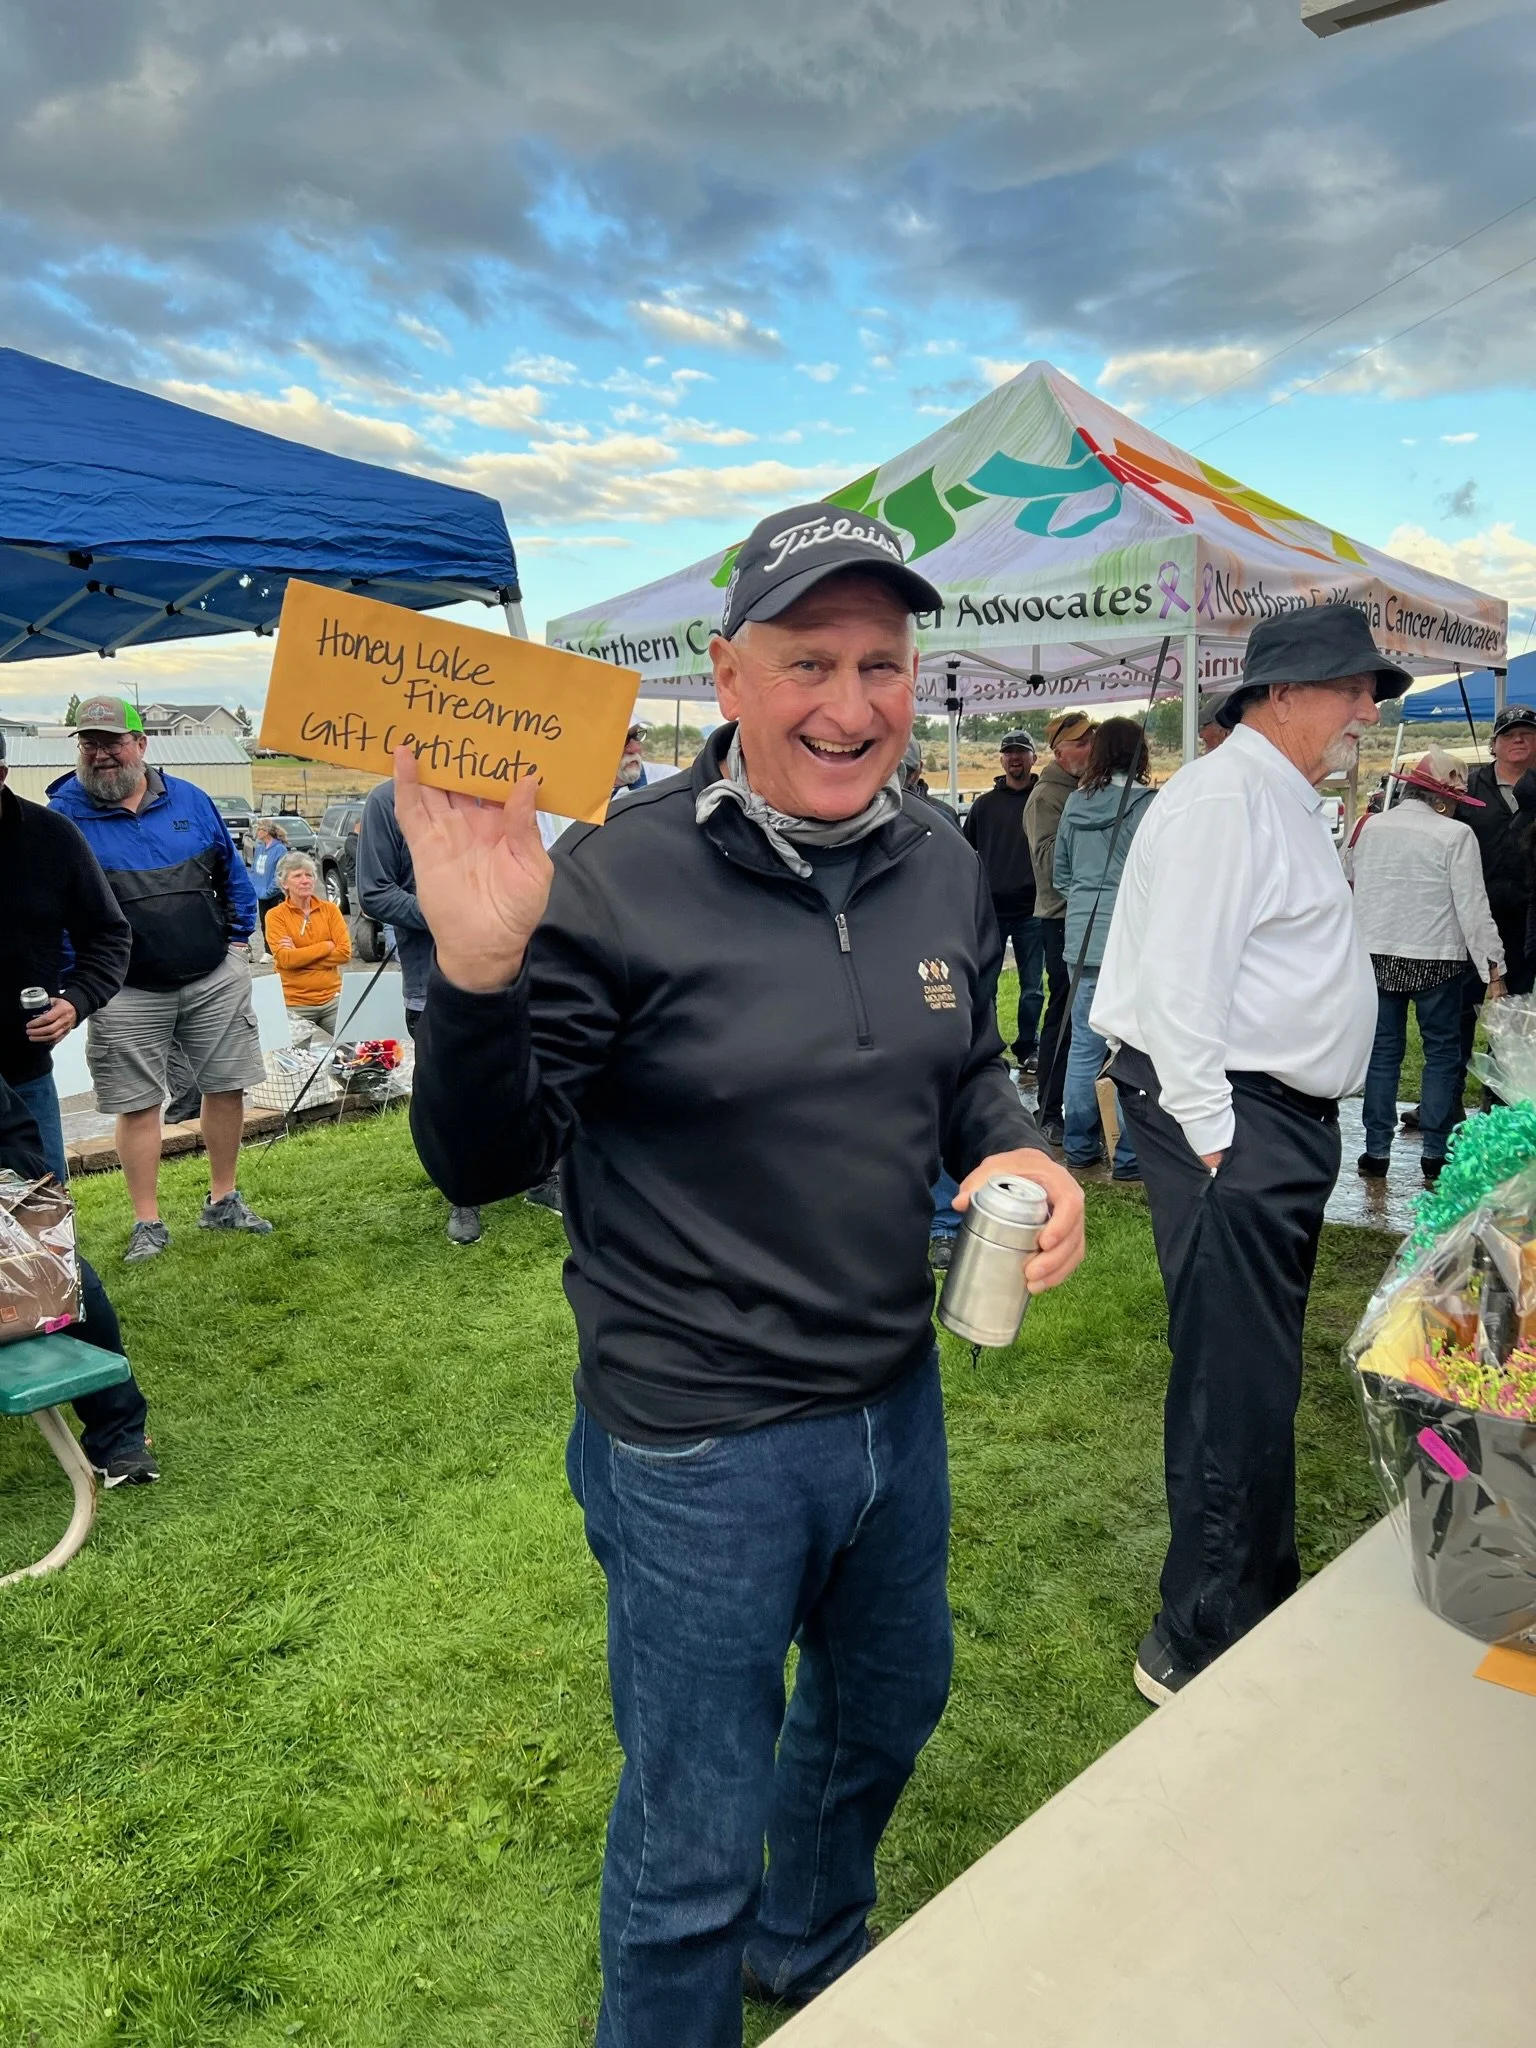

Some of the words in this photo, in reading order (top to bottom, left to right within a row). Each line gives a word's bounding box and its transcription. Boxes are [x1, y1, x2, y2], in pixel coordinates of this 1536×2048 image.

[956, 582, 1153, 628] Advocates
[1385, 595, 1437, 639] Cancer
[1434, 608, 1500, 651] Advocates
[316, 617, 405, 685] Honey
[416, 641, 496, 686] Lake
[300, 711, 378, 752] Gift
[403, 678, 563, 741] Firearms
